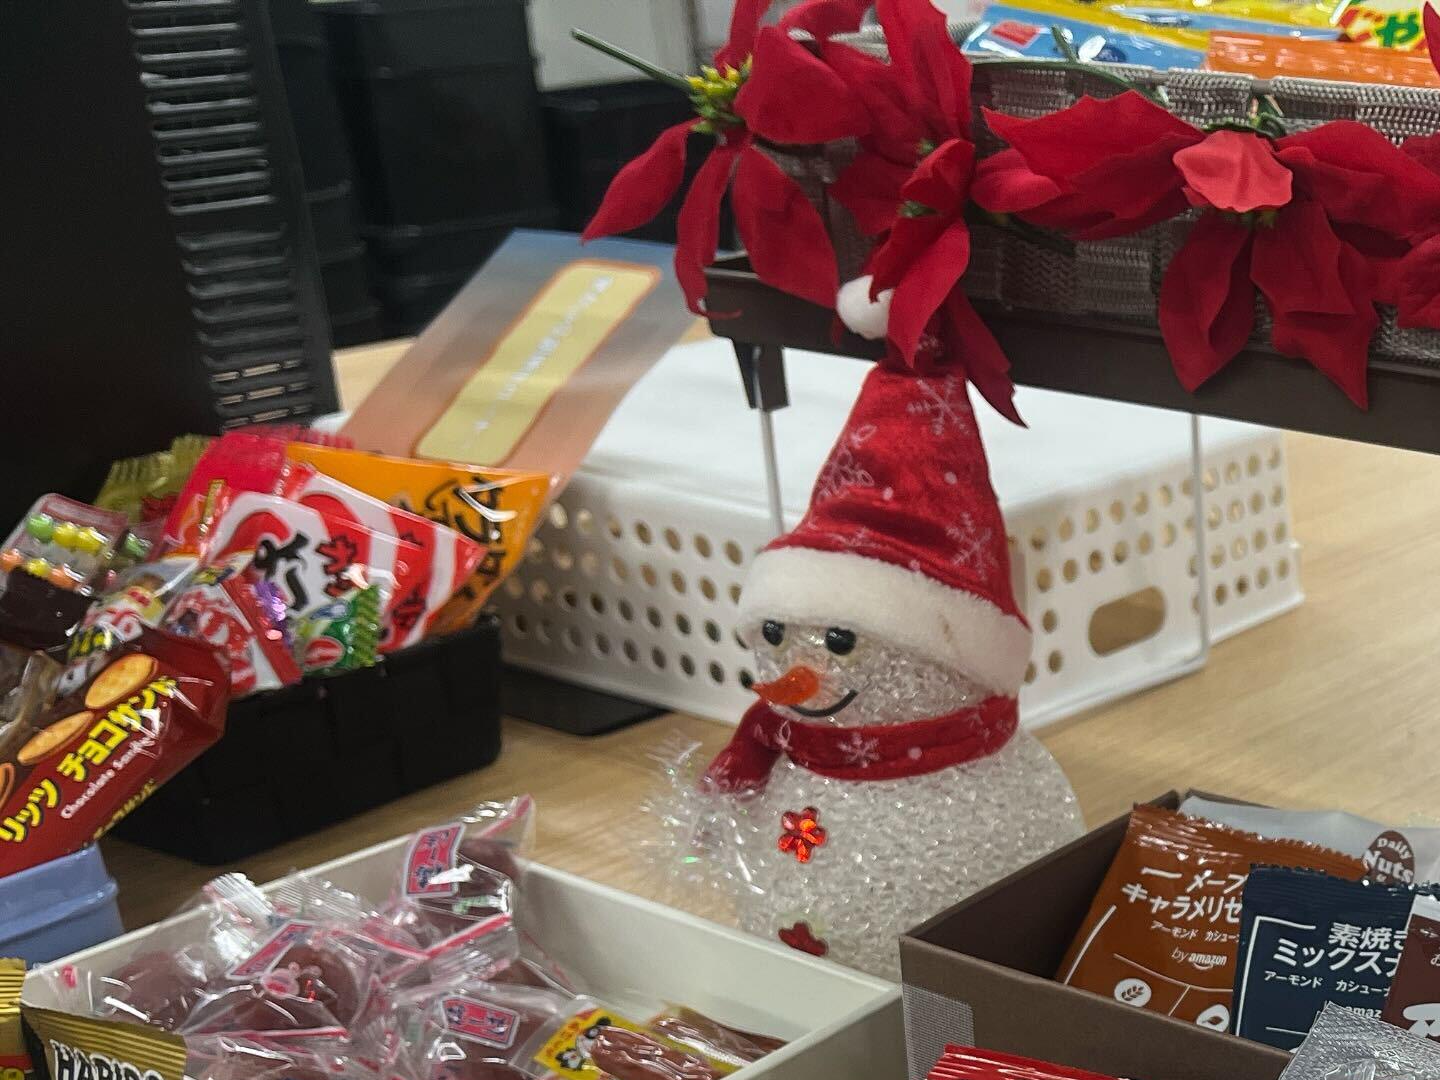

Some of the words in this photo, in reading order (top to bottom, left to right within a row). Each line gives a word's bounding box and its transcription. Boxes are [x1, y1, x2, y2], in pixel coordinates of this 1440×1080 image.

[1376, 836, 1413, 860] Daily
[1362, 850, 1414, 883] Nuts
[1204, 930, 1241, 943] カシュー
[1171, 947, 1187, 964] by
[1188, 952, 1229, 966] amazon
[1264, 970, 1323, 988] アーモンド
